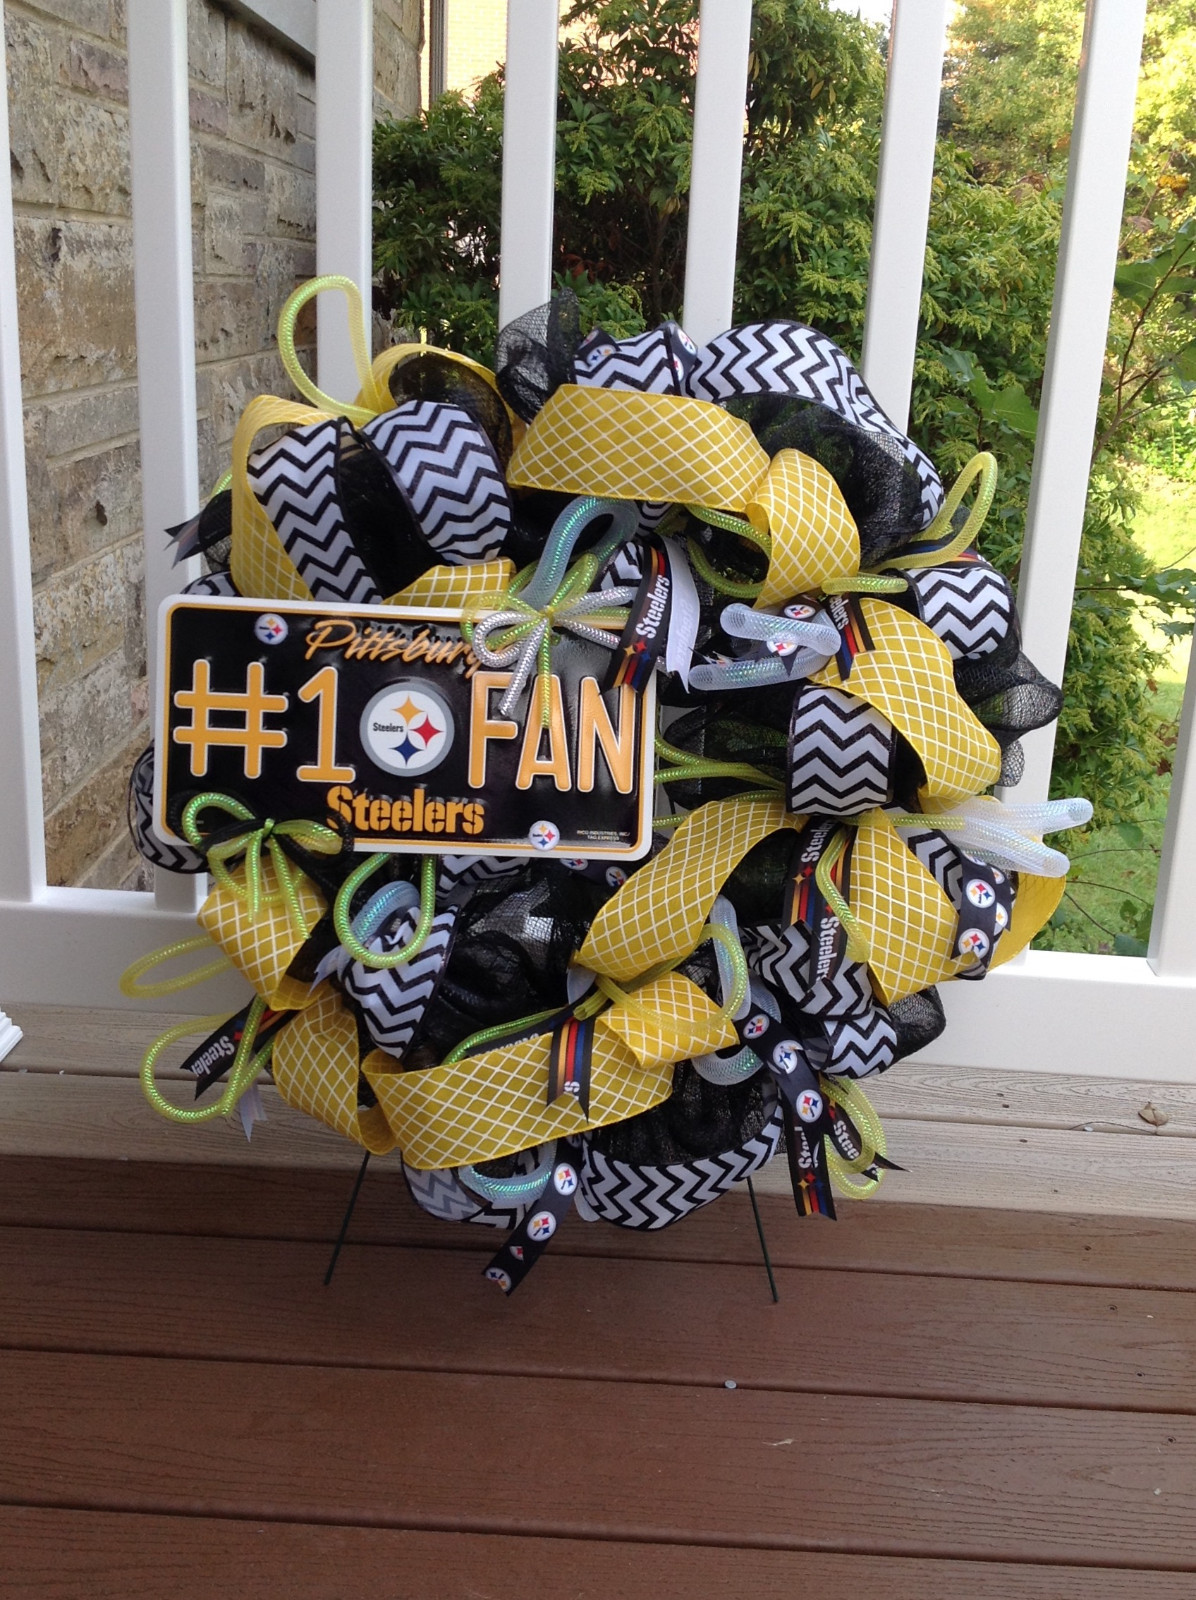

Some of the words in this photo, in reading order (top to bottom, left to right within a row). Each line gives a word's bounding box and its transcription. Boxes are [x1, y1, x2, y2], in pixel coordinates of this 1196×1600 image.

[635, 574, 671, 639] Steelers
[305, 619, 483, 679] Pittsburg
[173, 659, 356, 783] #1
[468, 671, 636, 795] FAN
[372, 722, 404, 733] Steelers
[326, 785, 485, 835] Steelers
